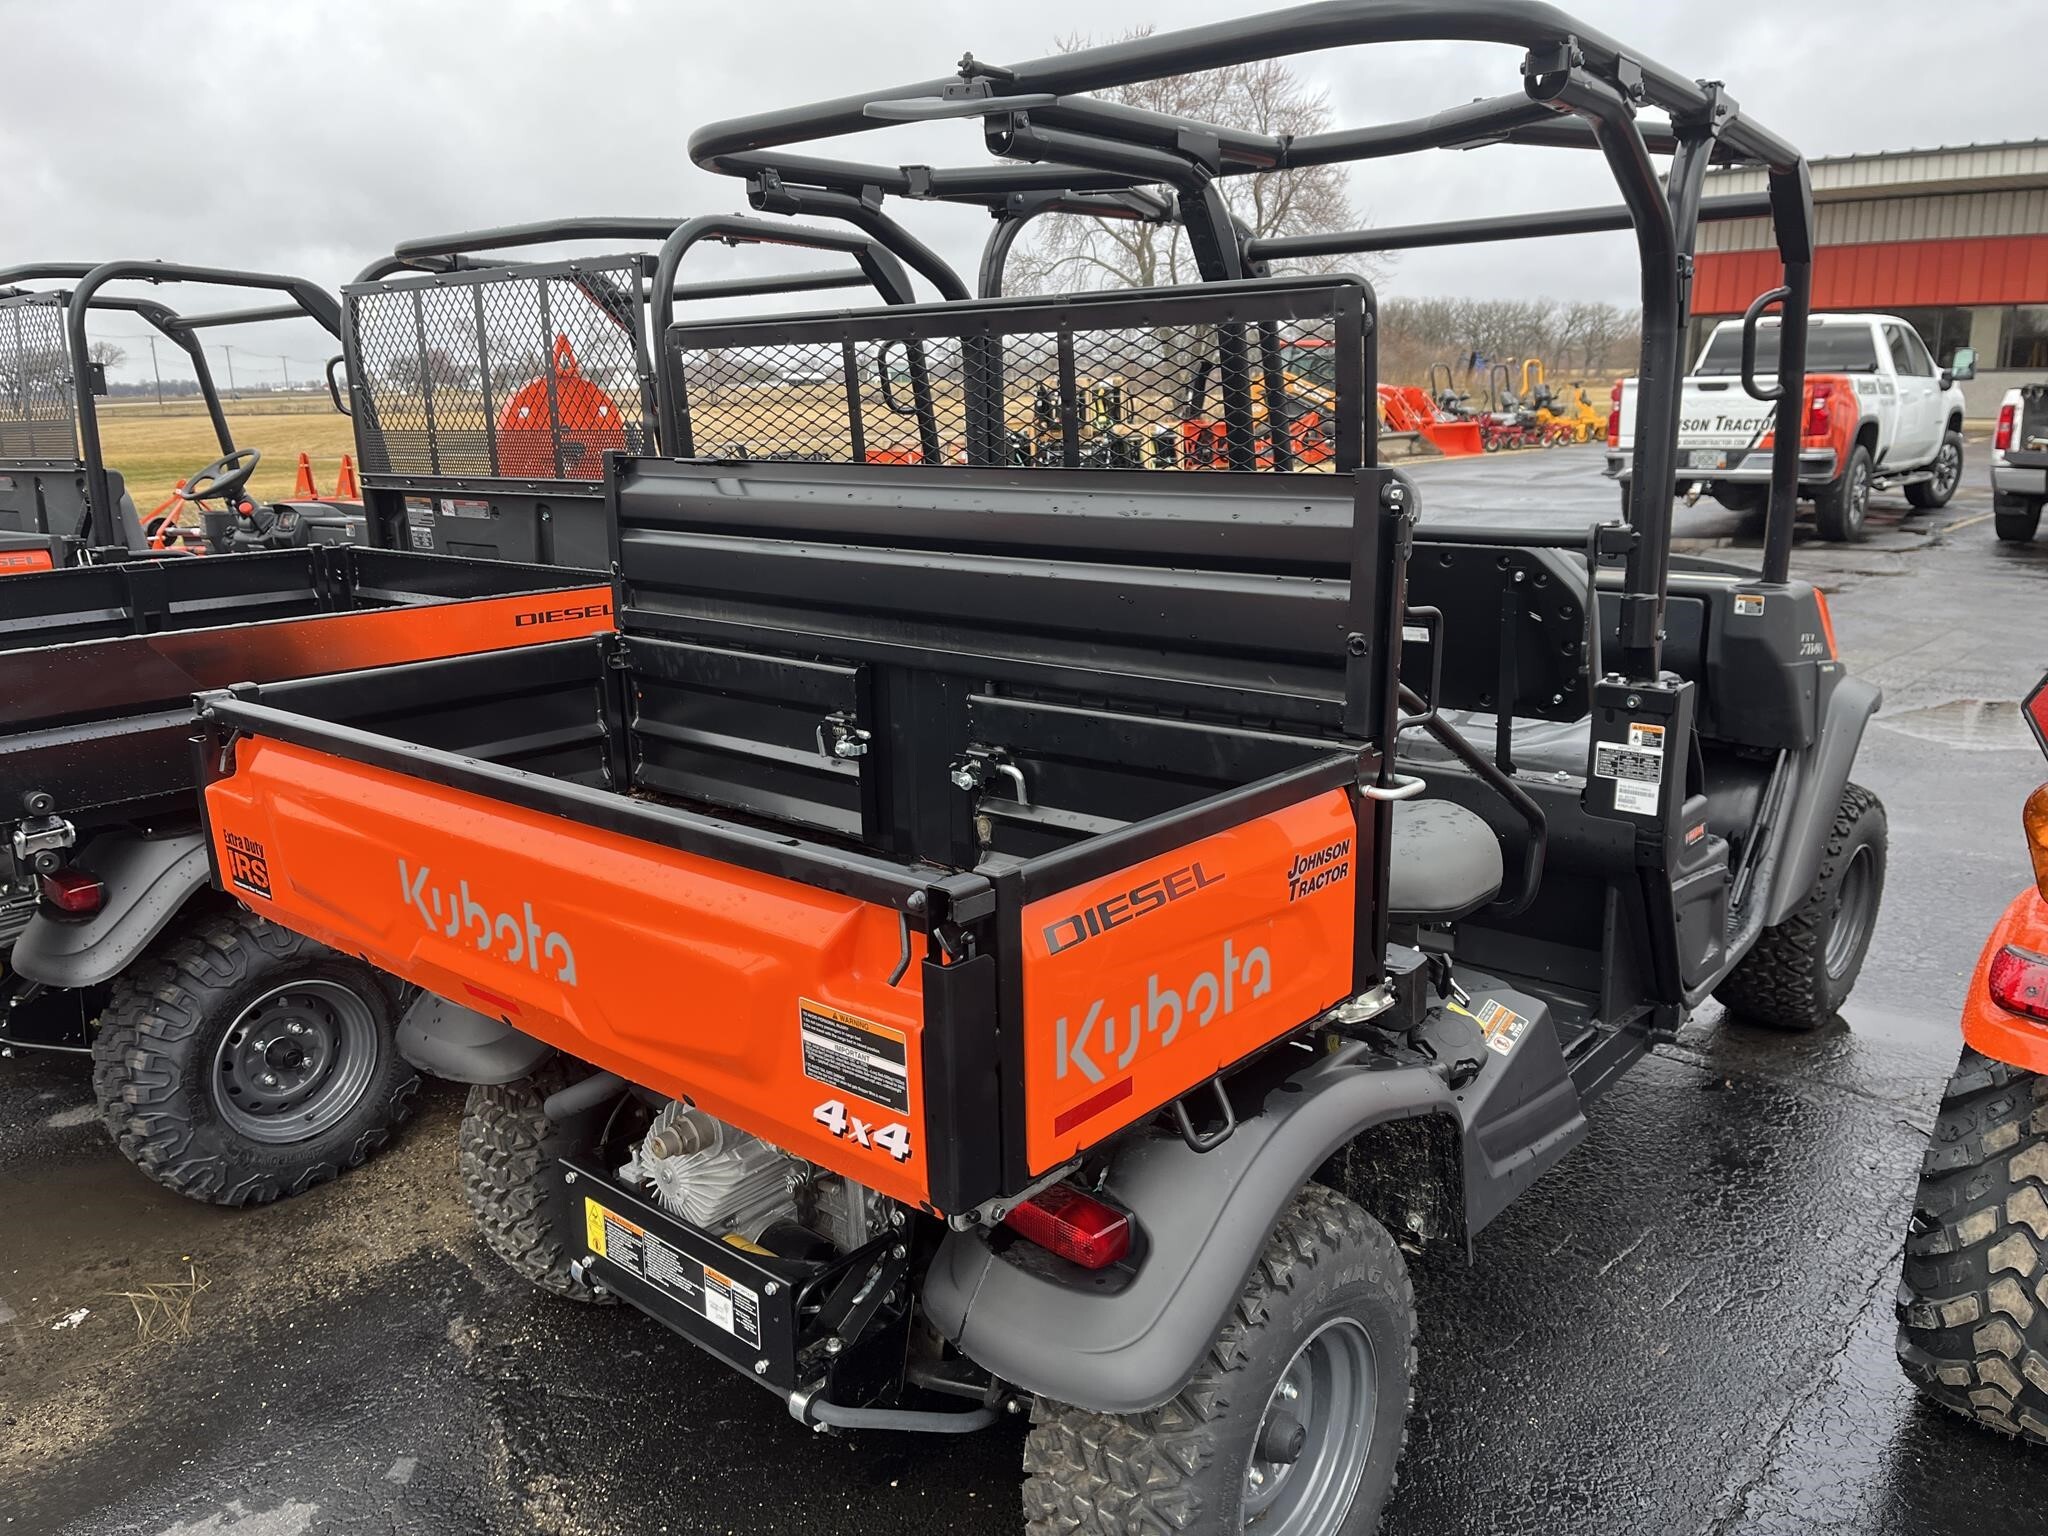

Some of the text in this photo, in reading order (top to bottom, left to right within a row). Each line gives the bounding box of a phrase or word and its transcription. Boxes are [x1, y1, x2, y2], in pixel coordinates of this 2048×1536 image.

[1679, 419, 1711, 431] SON
[515, 604, 614, 627] DIESEL
[223, 828, 264, 859] Extra Duty
[1288, 838, 1350, 879] JOHNSON
[228, 849, 269, 888] IRS
[1289, 862, 1349, 902] TRACTOR
[397, 858, 578, 986] Kubota
[1043, 862, 1226, 956] DIESEL
[839, 1013, 870, 1031] WARNING
[1055, 938, 1271, 1084] Kubota
[834, 1044, 871, 1064] IMPORTANT
[813, 1099, 912, 1162] 4x4
